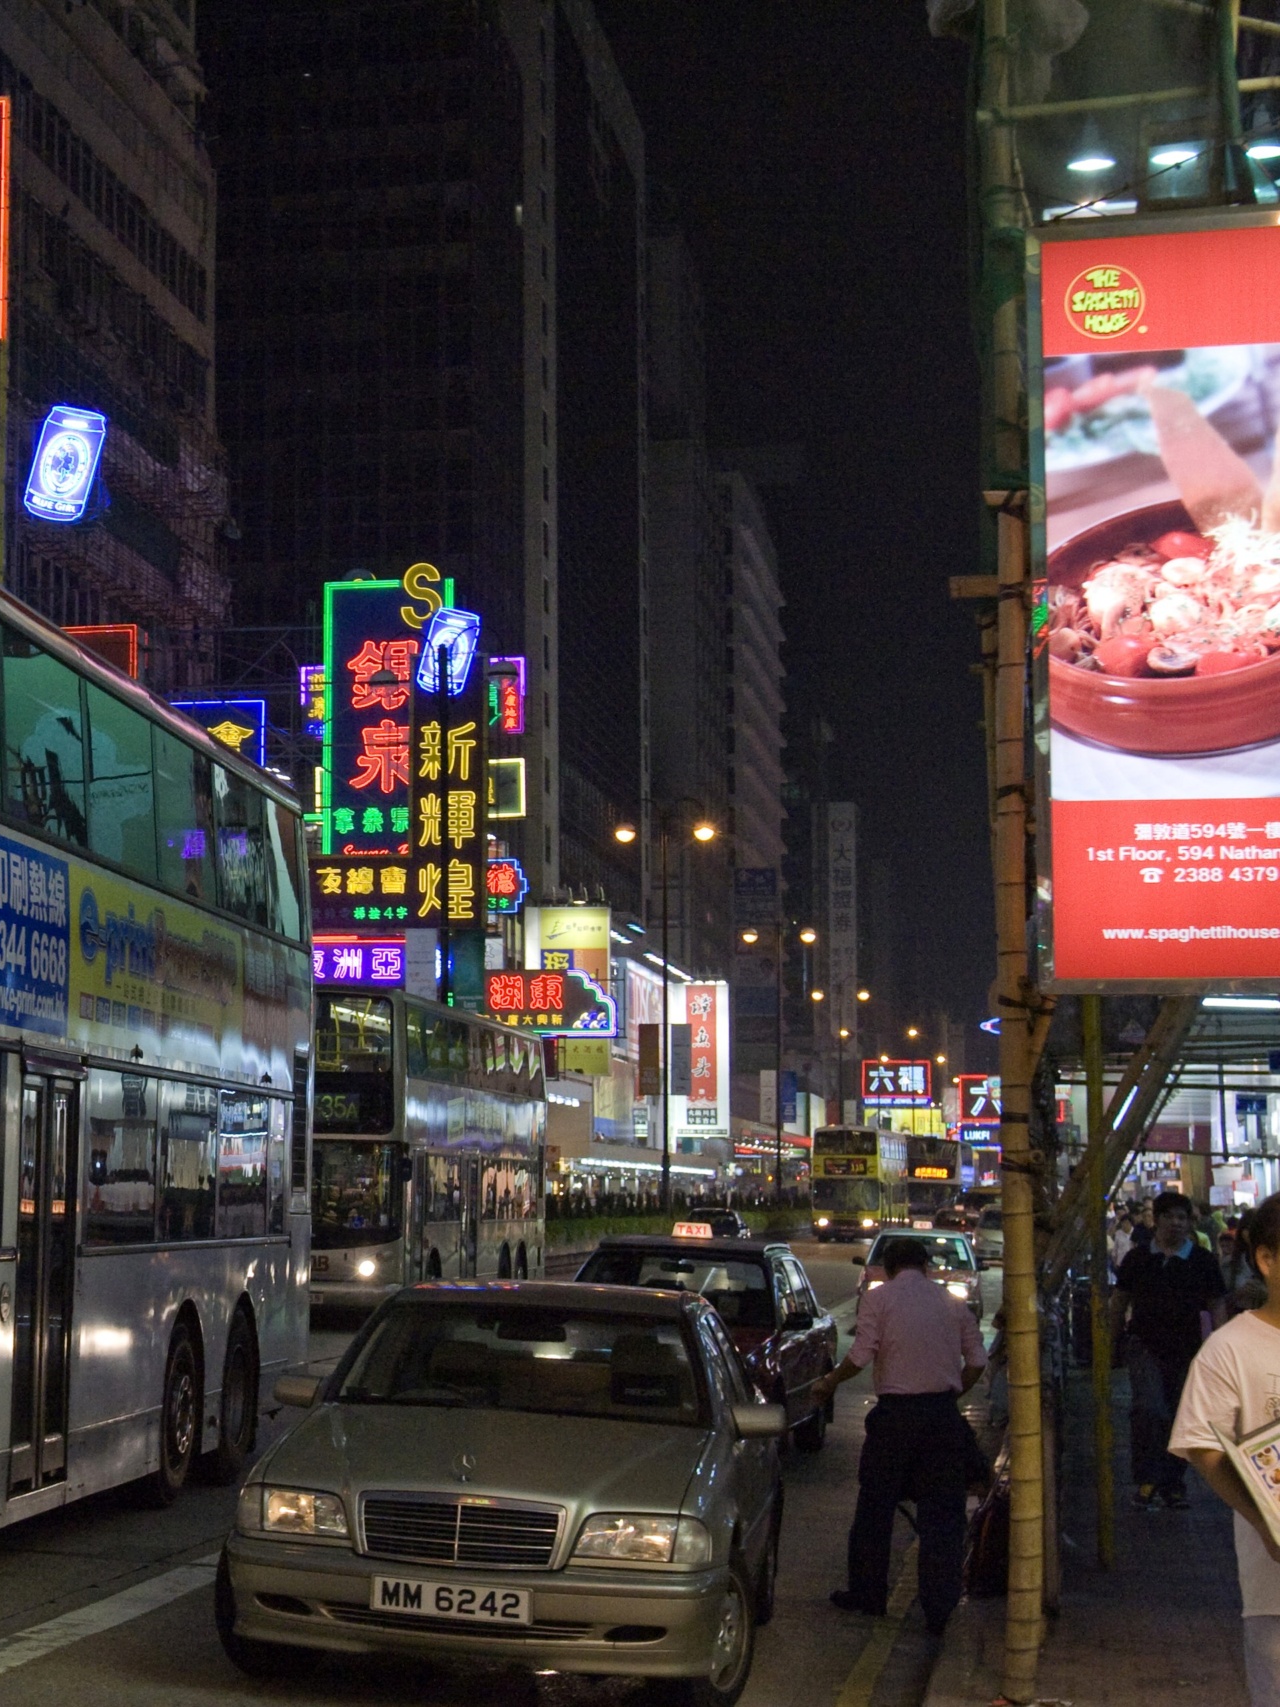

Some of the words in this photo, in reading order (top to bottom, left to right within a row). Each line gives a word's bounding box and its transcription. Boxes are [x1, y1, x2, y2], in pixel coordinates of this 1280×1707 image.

[1084, 268, 1121, 289] THE
[1084, 311, 1131, 334] HOUSE
[418, 721, 477, 919] 新輝煌
[1086, 846, 1115, 862] 1st
[1119, 846, 1172, 863] Floor,
[1177, 845, 1215, 861] 594
[315, 866, 408, 895] 夜總會
[1173, 867, 1223, 882] 2388
[1229, 866, 1279, 881] 4379
[31, 930, 66, 987] 6668
[677, 1224, 708, 1236] TAXI
[380, 1580, 423, 1610] MM
[434, 1586, 521, 1620] 6242
